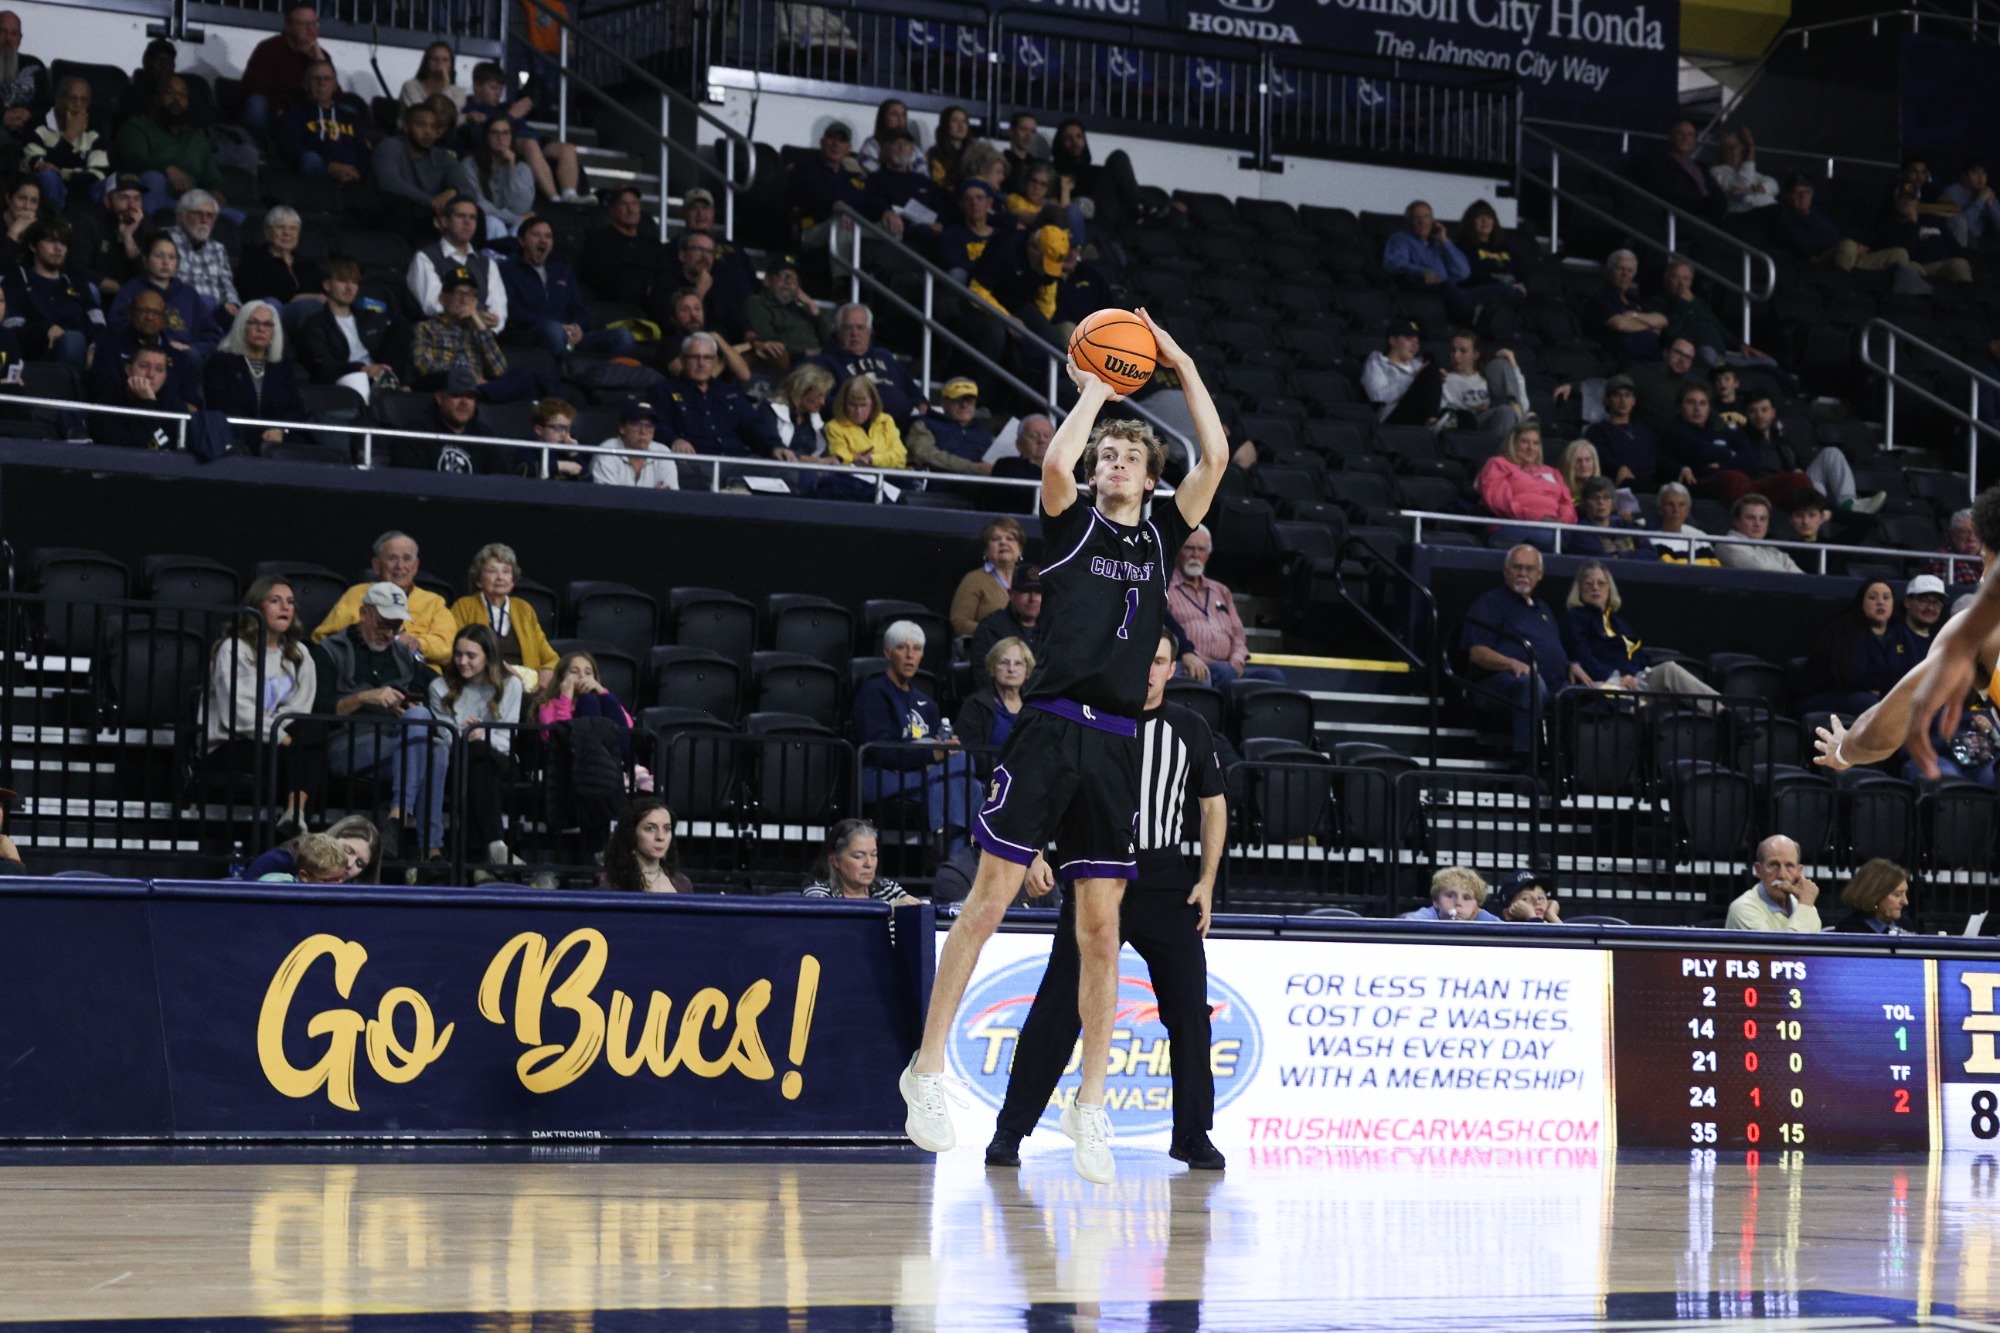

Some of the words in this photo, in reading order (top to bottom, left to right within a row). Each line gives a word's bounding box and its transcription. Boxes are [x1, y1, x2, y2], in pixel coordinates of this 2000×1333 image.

[1188, 12, 1301, 45] HONDA
[1467, 0, 1541, 46] City
[1547, 0, 1666, 51] Honda
[1375, 29, 1416, 60] The
[1418, 37, 1512, 71] Johnson
[1515, 49, 1558, 85] City
[1563, 55, 1610, 92] Way
[1104, 354, 1152, 380] Wilson
[391, 592, 406, 607] E
[1116, 587, 1139, 640] 1
[1682, 958, 1717, 977] PLY
[1726, 960, 1760, 979] FLS
[1770, 961, 1807, 980] PTS
[1285, 973, 1345, 997] FOR
[1354, 975, 1427, 999] LESS
[1438, 977, 1510, 1000] THAN
[1521, 979, 1571, 1001] THE
[1702, 987, 1717, 1007] 2
[1744, 987, 1758, 1008] 0
[1788, 988, 1802, 1009] 3
[257, 933, 455, 1112] Go
[478, 927, 821, 1100] Bucs!
[1288, 1004, 1369, 1028] COST
[1372, 1005, 1412, 1028] OF
[1419, 1006, 1438, 1029] 2
[1882, 1004, 1915, 1021] TOL
[1688, 1018, 1715, 1039] 14
[1743, 1019, 1757, 1040] 0
[1776, 1020, 1802, 1041] 10
[1894, 1026, 1908, 1051] 1
[1307, 1036, 1394, 1058] WASH
[1404, 1037, 1495, 1059] EVERY
[1501, 1039, 1555, 1060] DAY
[1692, 1051, 1717, 1072] 21
[1745, 1051, 1759, 1073] 0
[1789, 1052, 1803, 1074] 0
[1890, 1065, 1911, 1081] TF
[1279, 1065, 1352, 1088] WITH
[1358, 1067, 1378, 1089] A
[1386, 1068, 1585, 1091] MEMBERSHIP!
[1689, 1086, 1717, 1107] 24
[1750, 1087, 1761, 1107] 1
[1790, 1088, 1804, 1109] 0
[1894, 1088, 1910, 1113] 2
[532, 1130, 601, 1138] DAKTRONICS
[1248, 1117, 1599, 1142] TRUSHINECARWASH.COM
[1690, 1122, 1718, 1143] 35
[1747, 1122, 1760, 1143] 0
[1779, 1123, 1805, 1144] 15
